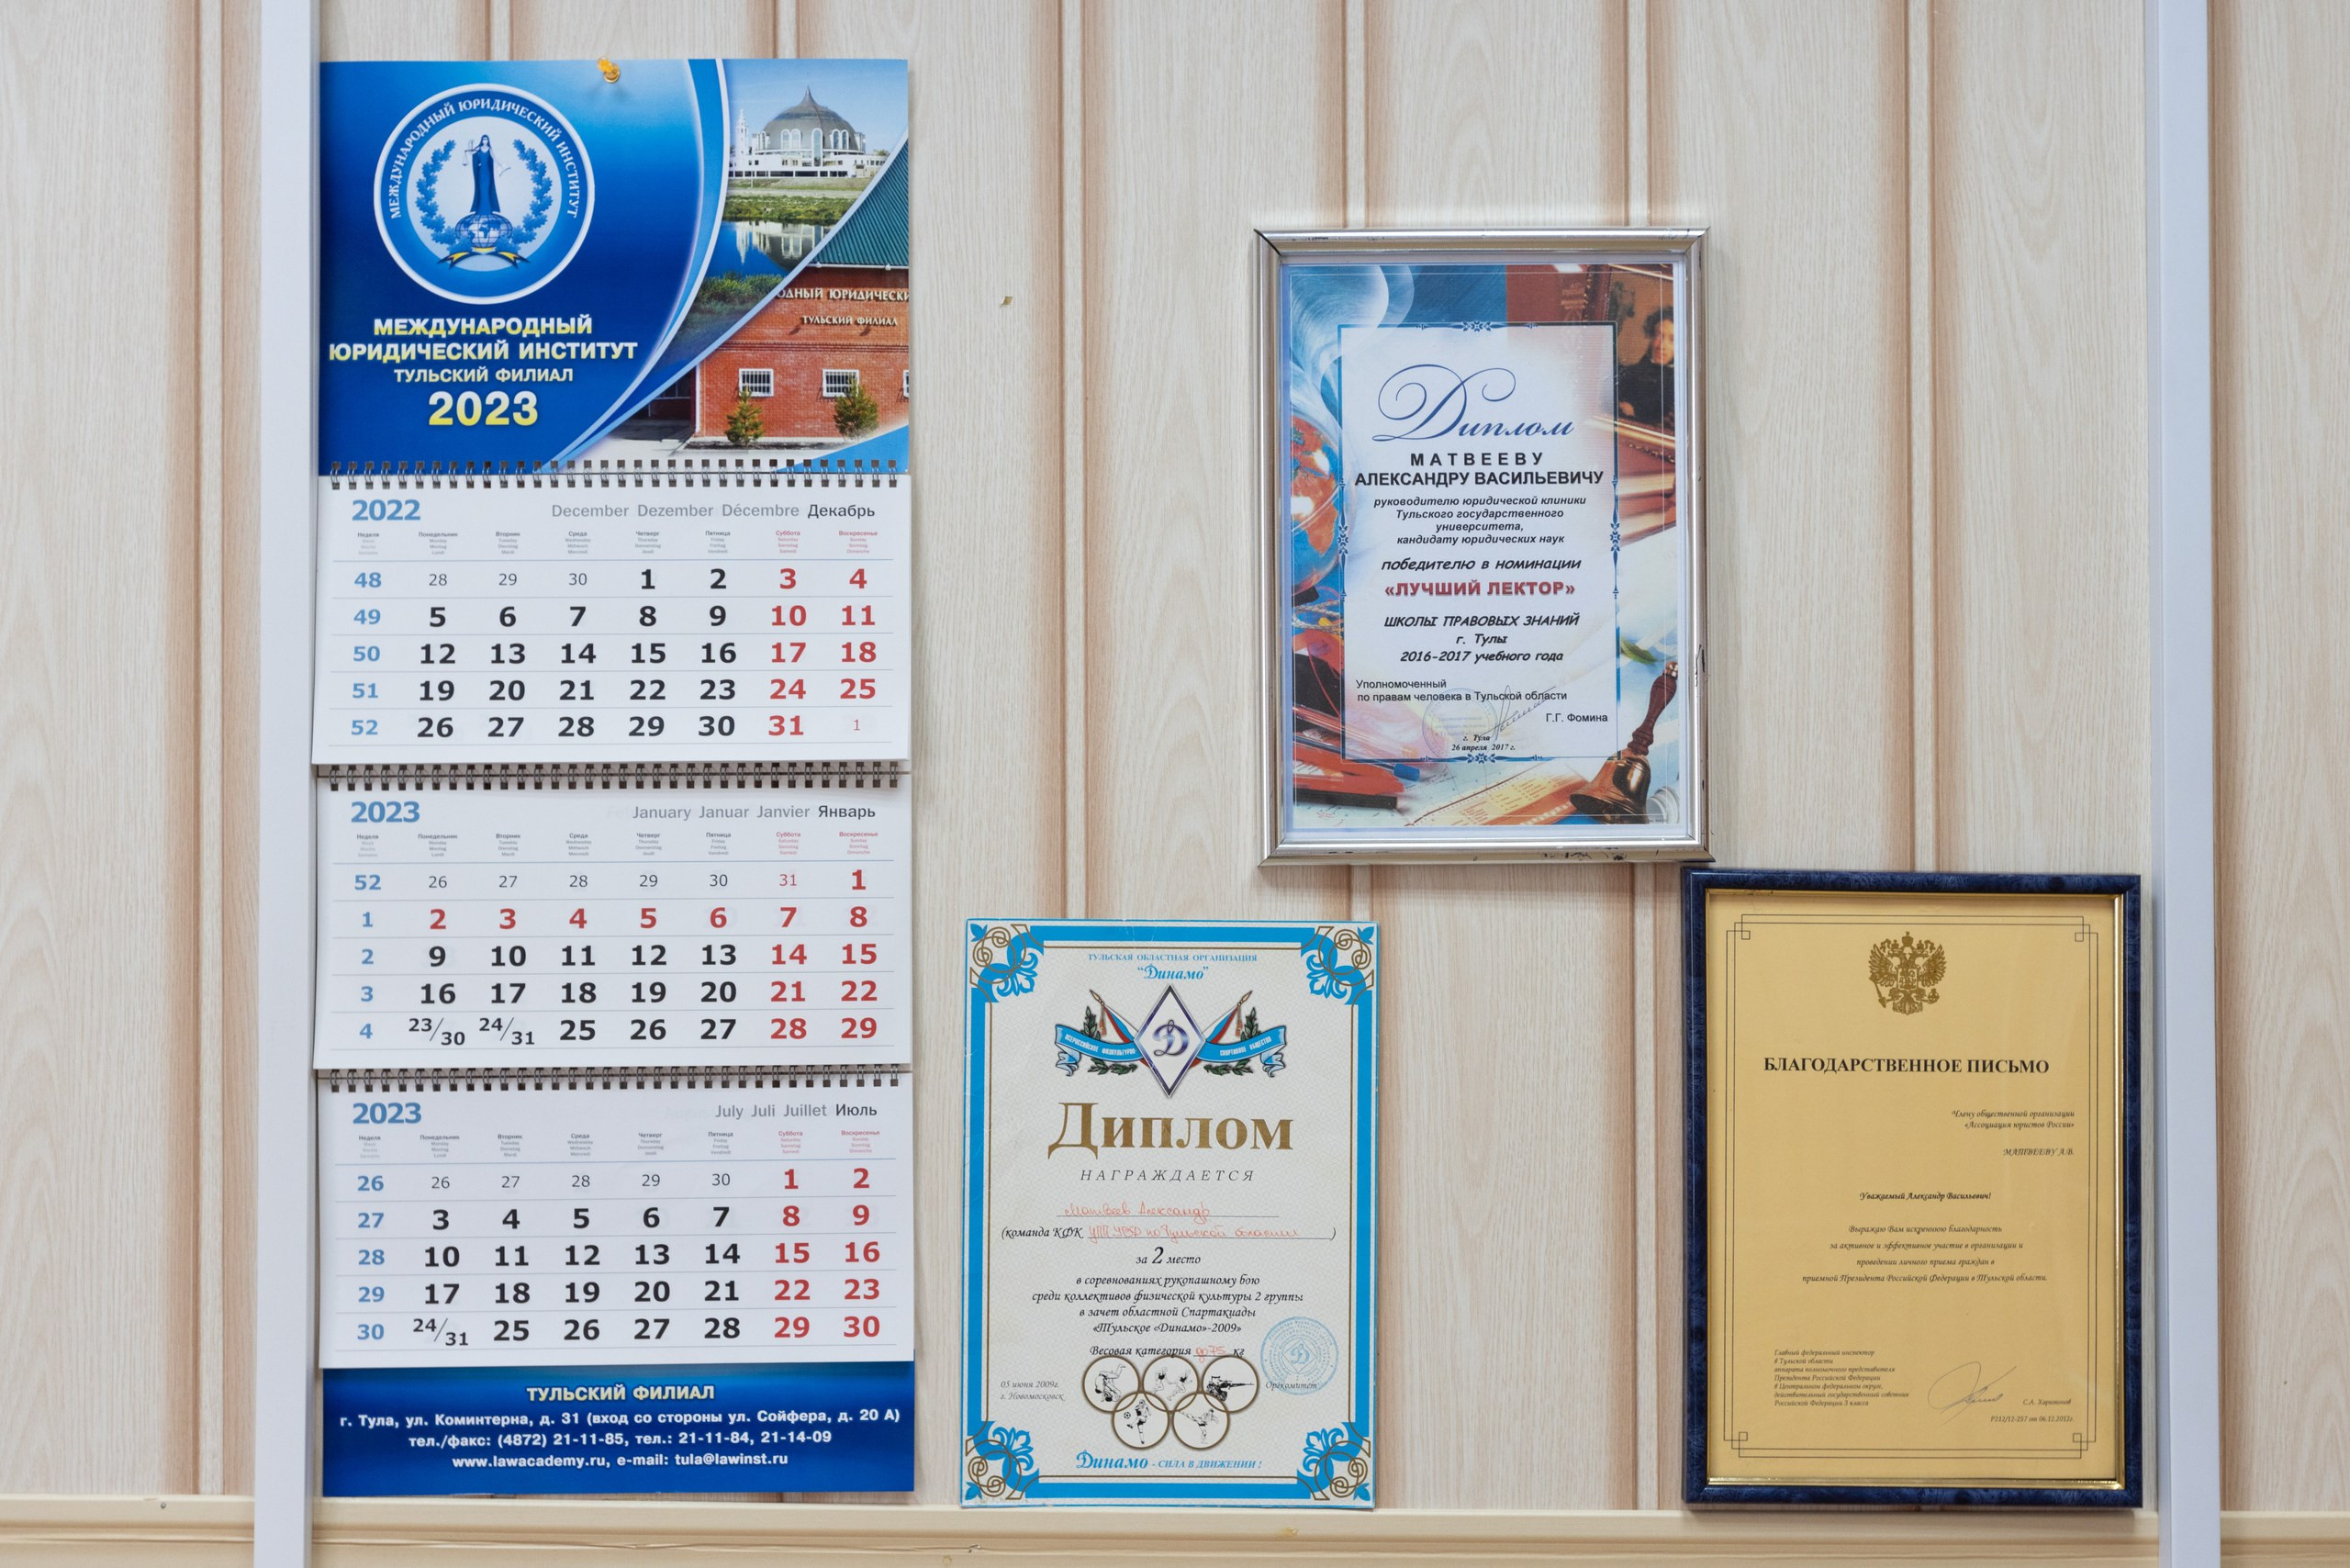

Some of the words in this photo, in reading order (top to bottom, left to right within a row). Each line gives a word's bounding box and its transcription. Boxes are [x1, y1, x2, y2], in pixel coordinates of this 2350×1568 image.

[389, 102, 455, 218] МЕЖДУНАРОДНЫЙ
[459, 98, 563, 141] ЮРИДИЧЕСКИЙ
[556, 141, 579, 218] ИНСТИТУТ
[374, 313, 592, 337] МЕЖДУНАРОДНЫЙ
[801, 315, 853, 326] ТУЛЬСКИЙ
[856, 317, 898, 327] ФИЛИАЛ
[329, 340, 509, 364] ЮРИДИЧЕСКИЙ
[519, 342, 638, 360] ИНСТИТУТ
[393, 365, 488, 383] ТУЛЬСКИЙ
[495, 367, 573, 382] ФИЛИАЛ
[428, 390, 538, 426] 2023
[1371, 364, 1574, 442] Диплом
[1410, 452, 1542, 466] МАТВЕЕВУ
[1354, 471, 1470, 487] АЛЕКСАНДРУ
[1474, 470, 1604, 485] ВАСИЛЬЕВИЧУ
[1373, 496, 1460, 509] руководителю
[1462, 495, 1538, 508] юридической
[352, 498, 420, 521] 2022
[552, 504, 629, 517] December
[637, 504, 714, 517] Dezember
[722, 503, 800, 517] Décembre
[807, 503, 875, 520] Декабрь
[1396, 509, 1453, 521] Тульского
[1456, 509, 1563, 520] государственного
[1435, 523, 1523, 533] университета,
[1396, 534, 1459, 546] кандидату
[1460, 534, 1537, 545] юридических
[1539, 535, 1564, 545] наук
[1381, 558, 1476, 571] победителю
[1481, 560, 1490, 569] в
[1494, 559, 1582, 570] номинации
[1384, 579, 1481, 597] «ЛУЧШИЙ
[1486, 581, 1575, 596] ЛЕКТОР»
[1383, 616, 1438, 627] ШКОЛЫ
[1442, 615, 1520, 626] ПРАВОВЫХ
[1522, 612, 1580, 626] ЗНАНИЙ
[1455, 635, 1465, 644] г.
[1474, 633, 1508, 646] Тулы
[1400, 651, 1472, 662] 2016-2017
[1473, 651, 1531, 664] учебного
[1535, 653, 1563, 662] года
[1355, 678, 1447, 689] Уполномоченный
[1372, 693, 1411, 703] правам
[1413, 693, 1462, 701] человека
[1473, 690, 1522, 703] Тульской
[1524, 690, 1567, 702] области
[1546, 712, 1563, 722] Г.Г.
[1566, 712, 1607, 722] Фомина
[351, 799, 420, 823] 2023
[632, 806, 691, 821] January
[699, 805, 749, 818] Januar
[756, 805, 811, 818] Janvier
[818, 804, 876, 820] Январь
[362, 948, 374, 965] 2
[429, 946, 446, 967] 9
[491, 945, 526, 967] 10
[562, 945, 595, 966] 11
[632, 944, 666, 966] 12
[701, 944, 736, 966] 13
[771, 944, 807, 965] 14
[842, 943, 877, 964] 15
[1088, 953, 1133, 961] ТУЛЬСКАЯ
[1136, 952, 1189, 961] ОБЛАСТНАЯ
[1191, 954, 1257, 962] ОРГАНИЗАЦИЯ
[1764, 1057, 1962, 1073] БЛАГОДАРСТВЕННОЕ
[1967, 1058, 2049, 1073] ПИСЬМО
[352, 1101, 421, 1125] 2023
[714, 1104, 744, 1120] July
[750, 1103, 775, 1117] Juli
[783, 1103, 827, 1117] Juillet
[835, 1103, 878, 1116] Июль
[1951, 1109, 1975, 1119] Члену
[1975, 1109, 2028, 1119] общественной
[2029, 1111, 2075, 1119] организации
[1047, 1102, 1293, 1159] Диплом
[2013, 1122, 2045, 1130] юристов
[2003, 1148, 2059, 1157] МАТВЕЕВУ
[1080, 1170, 1253, 1182] НАГРАЖДАЕТСЯ
[1859, 1192, 1905, 1201] Уважаемый
[1905, 1192, 1945, 1202] Александр
[1001, 1226, 1049, 1239] (команда
[1052, 1226, 1083, 1238] КФК
[1848, 1225, 1886, 1235] Выражаю
[1886, 1225, 1904, 1233] Вам
[1906, 1226, 1947, 1235] искреннюю
[1948, 1225, 2002, 1235] благодарность
[1151, 1246, 1164, 1264] 2
[1084, 1276, 1162, 1287] соревнованиях
[1163, 1276, 1237, 1287] рукопашному
[1239, 1273, 1259, 1284] бою
[1032, 1290, 1060, 1304] среди
[1064, 1293, 1131, 1303] коллективов
[1133, 1290, 1195, 1304] физической
[1198, 1293, 1251, 1304] культуры
[1254, 1291, 1261, 1301] 2
[1263, 1294, 1303, 1304] группы
[1122, 1305, 1178, 1316] областной
[1181, 1305, 1256, 1319] Спартакиады
[1092, 1321, 1150, 1335] «Тульское
[526, 1383, 625, 1402] ТУЛЬСКИЙ
[632, 1385, 714, 1400] ФИЛИАЛ
[340, 1417, 352, 1427] г.
[357, 1414, 399, 1428] Тула,
[405, 1416, 428, 1428] ул.
[434, 1413, 533, 1428] Коминтерна,
[539, 1415, 554, 1426] д.
[561, 1412, 578, 1424] 31
[587, 1412, 629, 1426] (вход
[633, 1414, 652, 1423] со
[657, 1413, 722, 1425] стороны
[727, 1413, 751, 1425] ул.
[756, 1409, 832, 1424] Сойфера,
[836, 1411, 853, 1423] д.
[859, 1408, 878, 1421] 20
[883, 1408, 900, 1423] А)
[408, 1434, 490, 1449] тел./факс:
[498, 1433, 547, 1449] (4872)
[553, 1432, 629, 1447] 21-11-85,
[634, 1435, 672, 1444] тел.:
[678, 1431, 754, 1445] 21-11-84,
[760, 1430, 832, 1443] 21-14-09
[452, 1454, 610, 1469] www.lawacademy.ru,
[616, 1453, 668, 1466] e-mail:
[674, 1452, 788, 1465] tula@lawinst.ru
[1076, 1450, 1148, 1469] Динамо
[1158, 1461, 1185, 1469] СИЛА
[1188, 1461, 1194, 1469] В
[1195, 1461, 1256, 1470] ДВИЖЕНИИ
